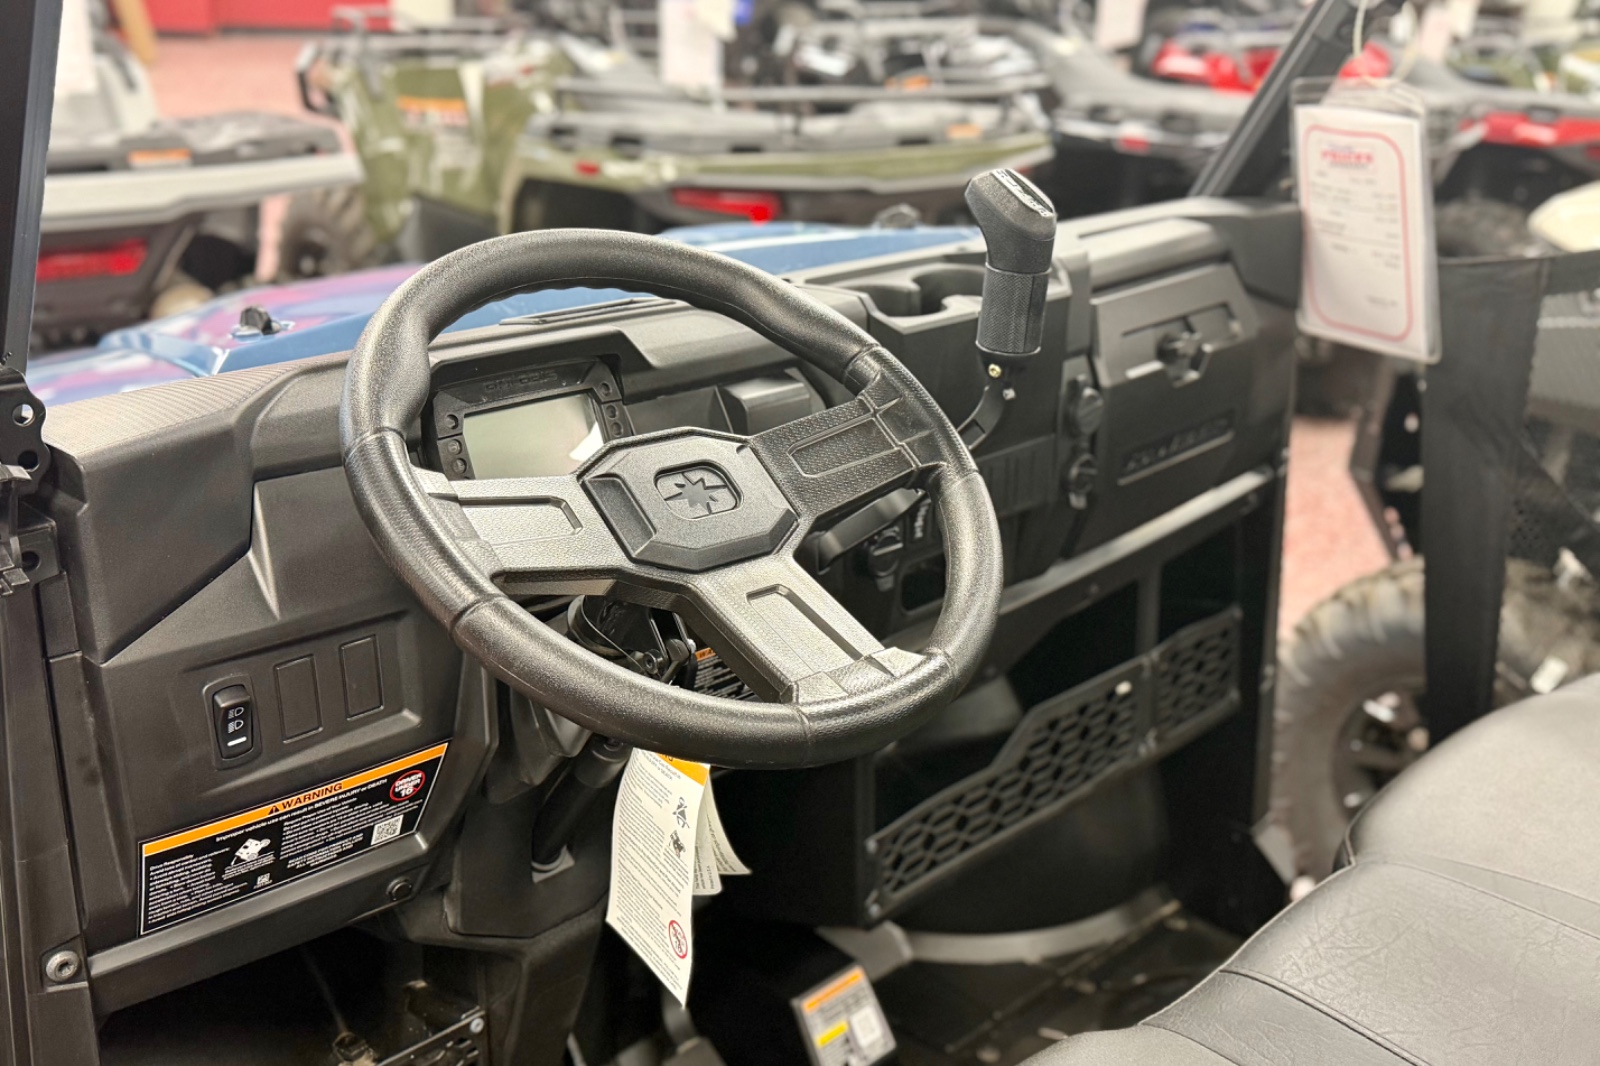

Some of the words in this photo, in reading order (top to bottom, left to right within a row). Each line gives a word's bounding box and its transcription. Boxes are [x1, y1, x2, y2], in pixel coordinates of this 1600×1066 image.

[281, 783, 343, 810] WARNING
[400, 788, 413, 797] 16
[215, 829, 245, 842] Improper
[314, 796, 338, 808] SEVERE
[367, 778, 388, 790] DEATH
